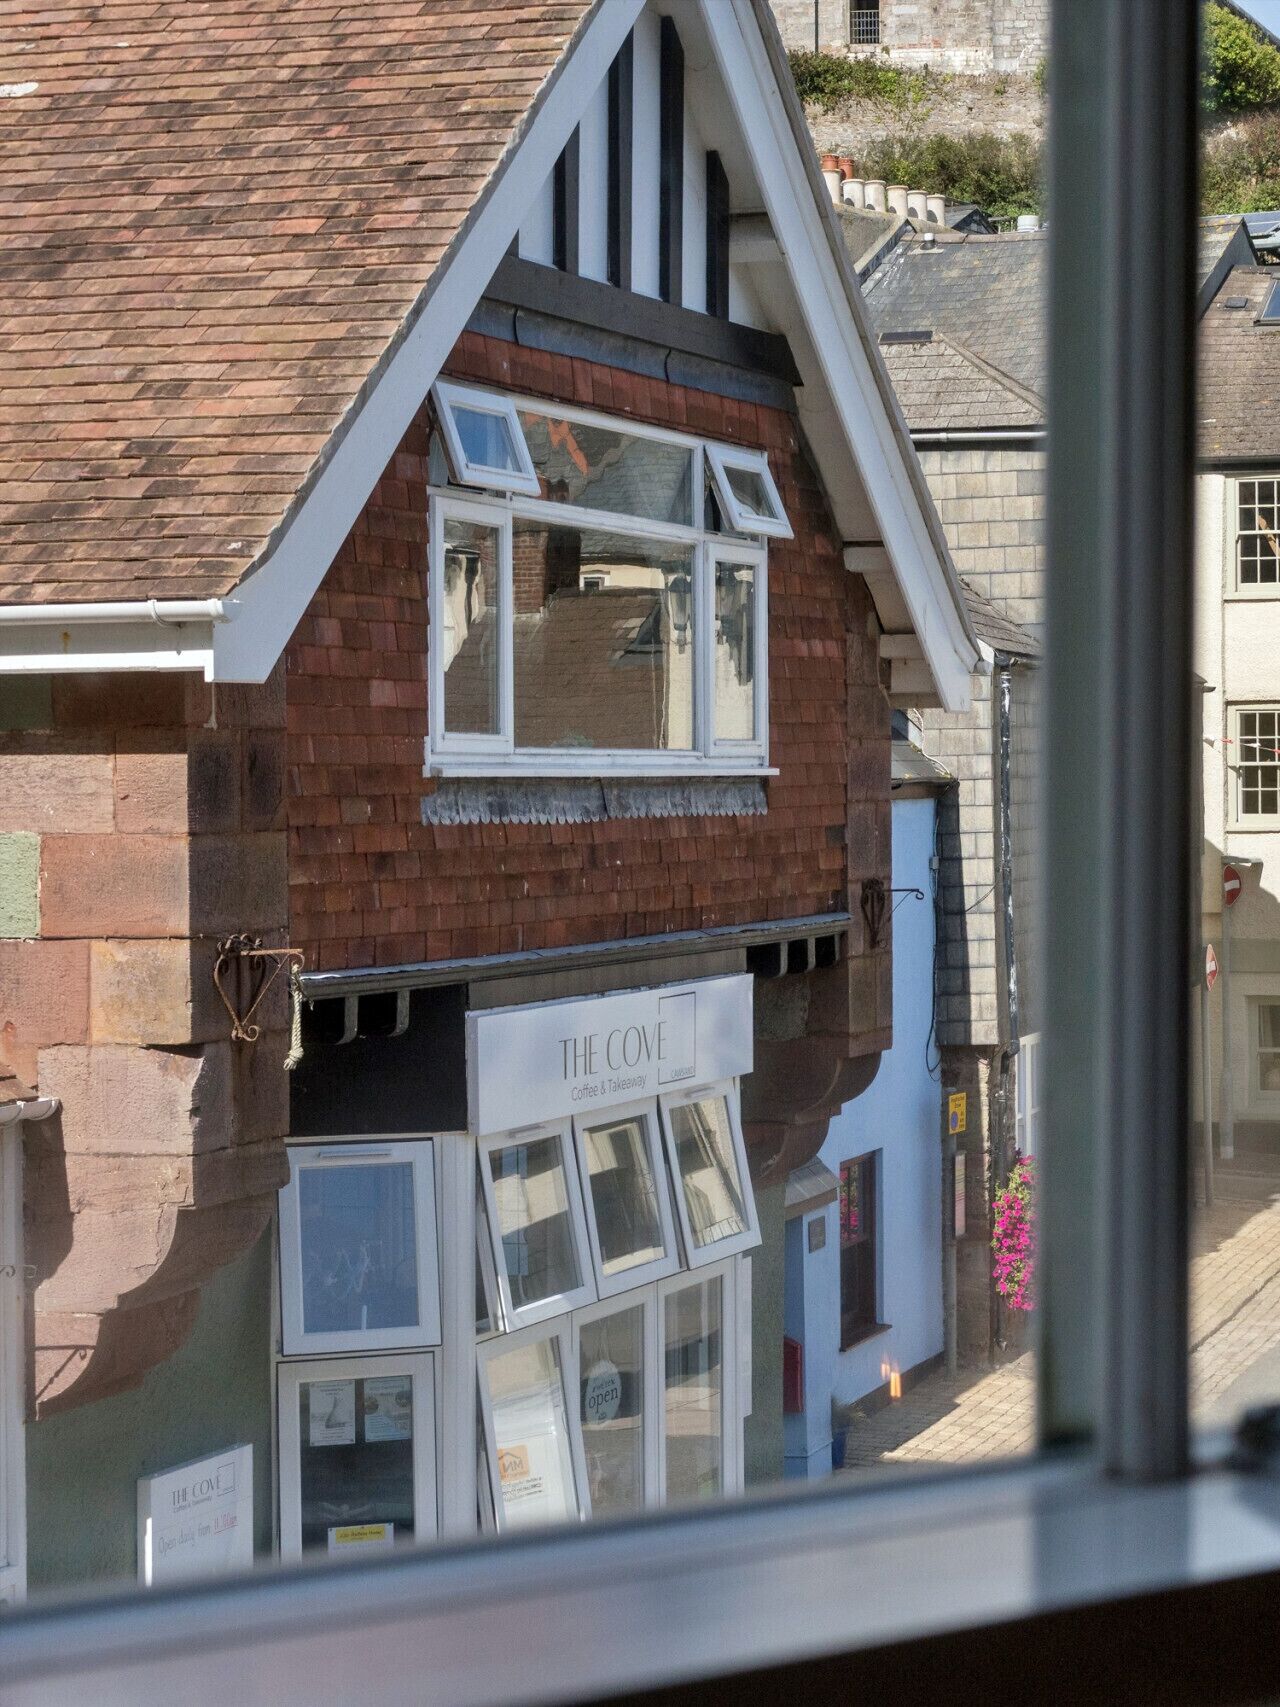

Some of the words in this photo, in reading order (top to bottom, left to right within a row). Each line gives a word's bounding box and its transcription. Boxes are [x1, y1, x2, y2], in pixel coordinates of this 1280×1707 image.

[558, 1033, 599, 1080] THE
[606, 1021, 667, 1070] COVE
[571, 1083, 599, 1101] Coffee
[600, 1081, 607, 1095] &
[608, 1073, 647, 1093] Takeaway
[588, 1387, 618, 1414] open
